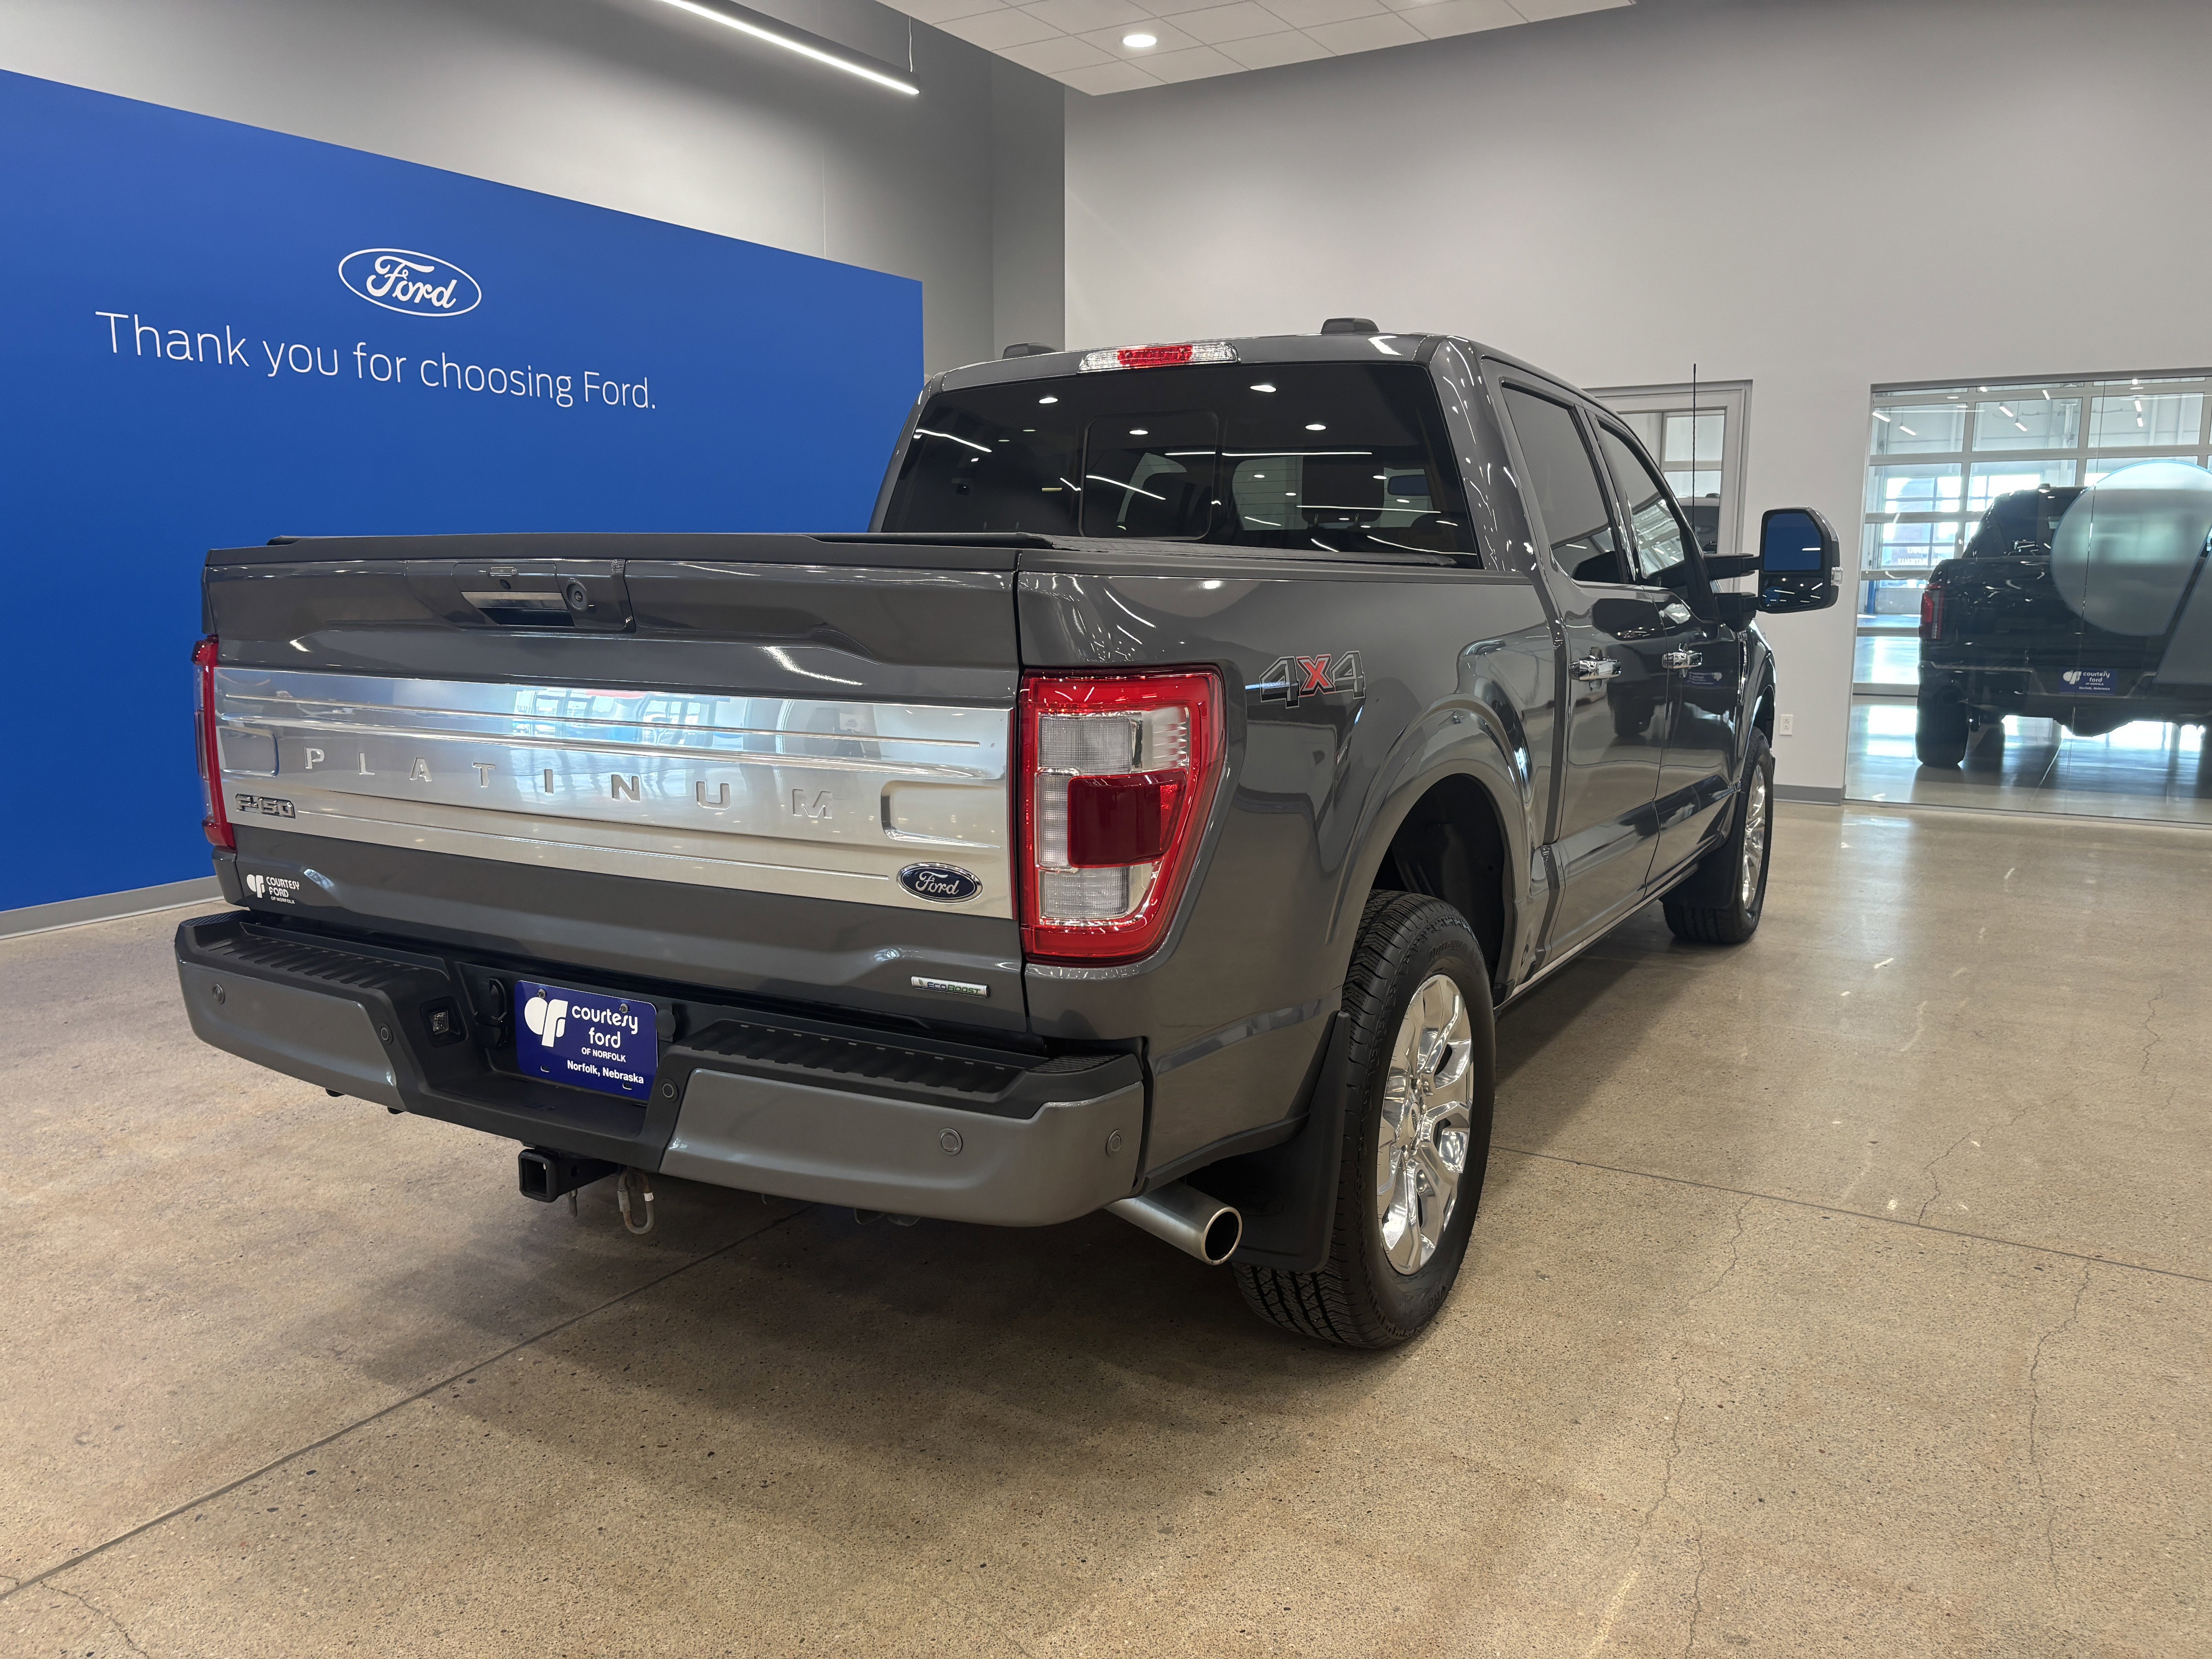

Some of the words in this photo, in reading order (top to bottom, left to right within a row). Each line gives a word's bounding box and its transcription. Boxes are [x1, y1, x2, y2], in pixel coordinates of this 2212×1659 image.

[366, 255, 458, 309] Ford
[95, 311, 250, 367] Thank
[262, 340, 338, 377] you
[352, 342, 407, 383] for
[420, 352, 574, 408] choosing
[584, 371, 656, 409] Ford.
[1259, 651, 1366, 709] 4X4
[304, 747, 833, 819] PLATINUM
[235, 793, 296, 819] F-150
[266, 876, 300, 890] COURTESY
[268, 886, 289, 898] FORD
[915, 871, 960, 895] Ford
[572, 1005, 638, 1035] courtesy
[588, 1027, 621, 1048] ford
[581, 1047, 591, 1055] OF
[592, 1049, 626, 1063] NORFOLK
[567, 1060, 601, 1077] Norfolk,
[603, 1067, 644, 1084] Nebraska
